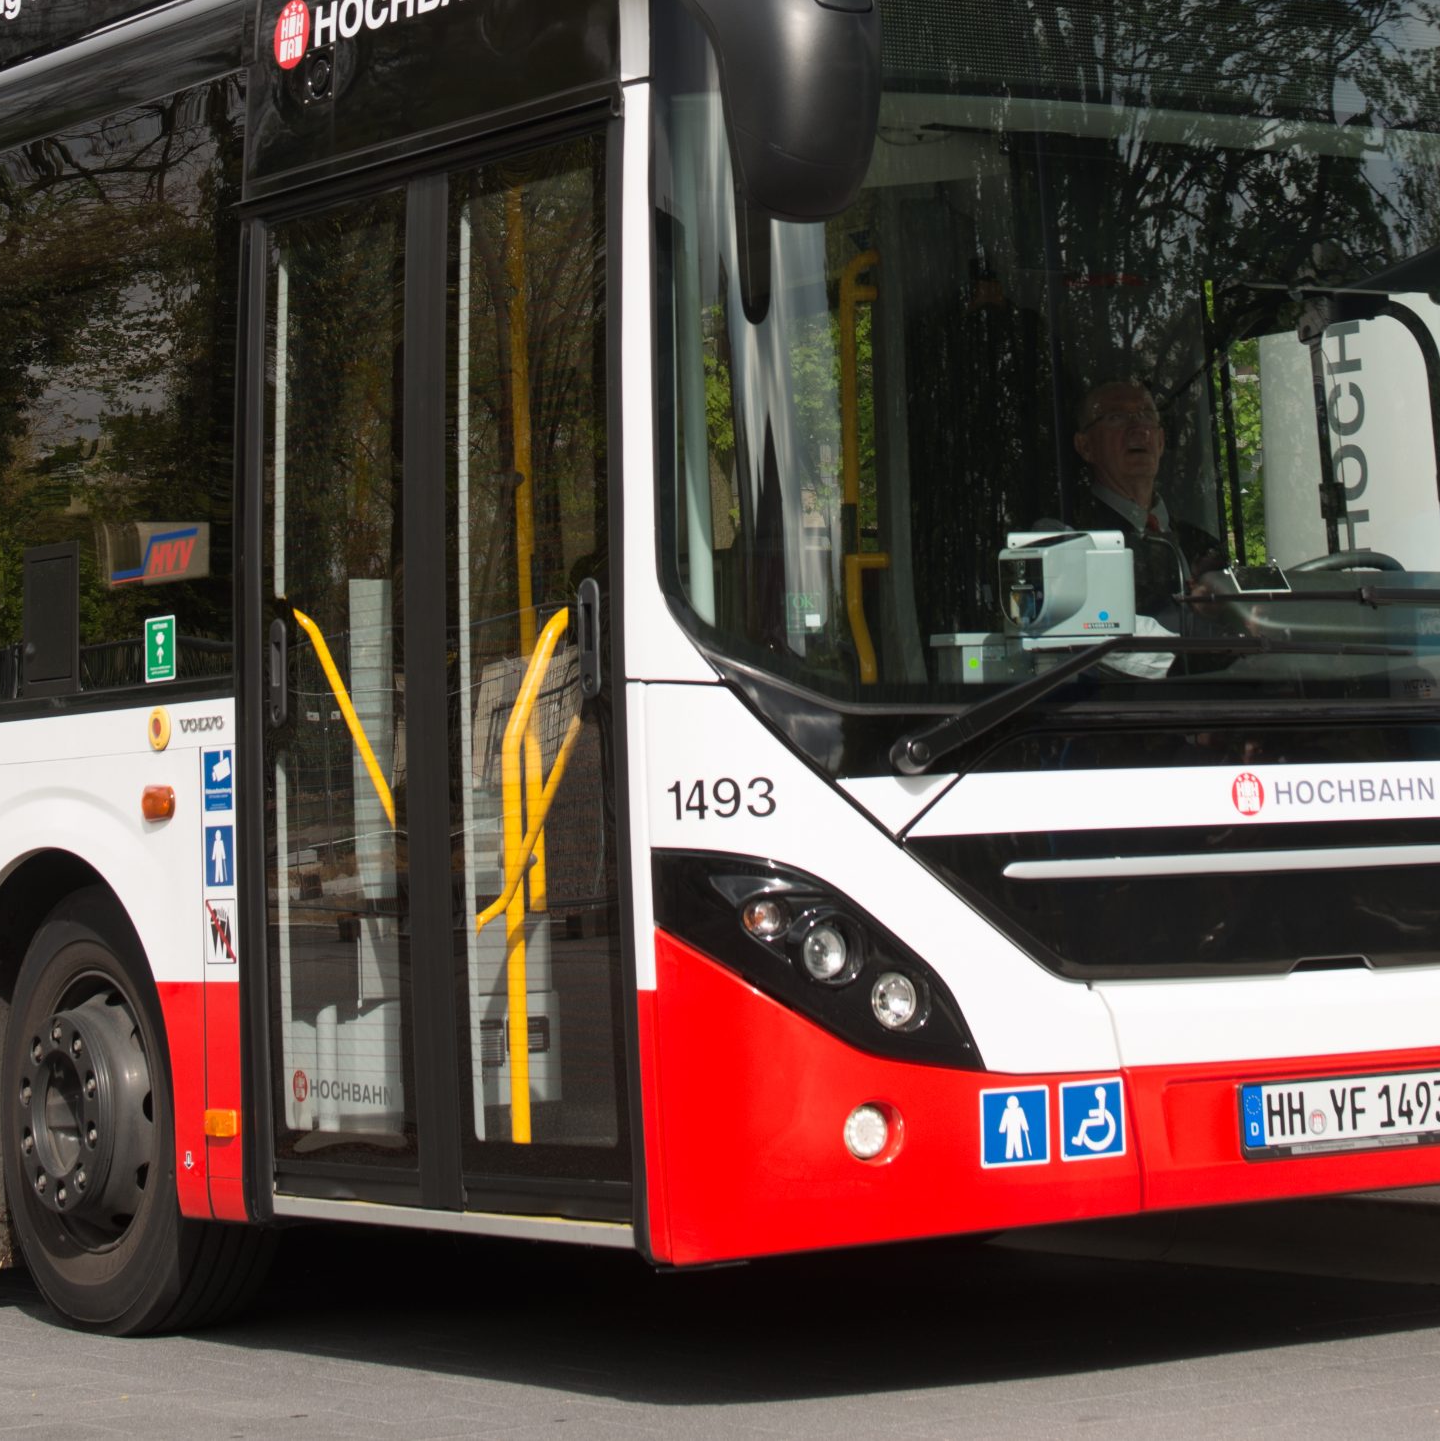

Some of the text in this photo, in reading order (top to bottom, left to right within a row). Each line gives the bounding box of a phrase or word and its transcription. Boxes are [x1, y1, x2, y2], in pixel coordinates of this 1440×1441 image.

[148, 537, 196, 575] HVV
[179, 715, 224, 734] VOLVO
[667, 777, 776, 820] 1493
[1274, 777, 1435, 805] HOCHBAHN
[310, 1078, 393, 1107] HOCHBAHN
[1266, 1091, 1306, 1137] HH
[1329, 1086, 1366, 1132] YF
[1250, 1121, 1259, 1136] D
